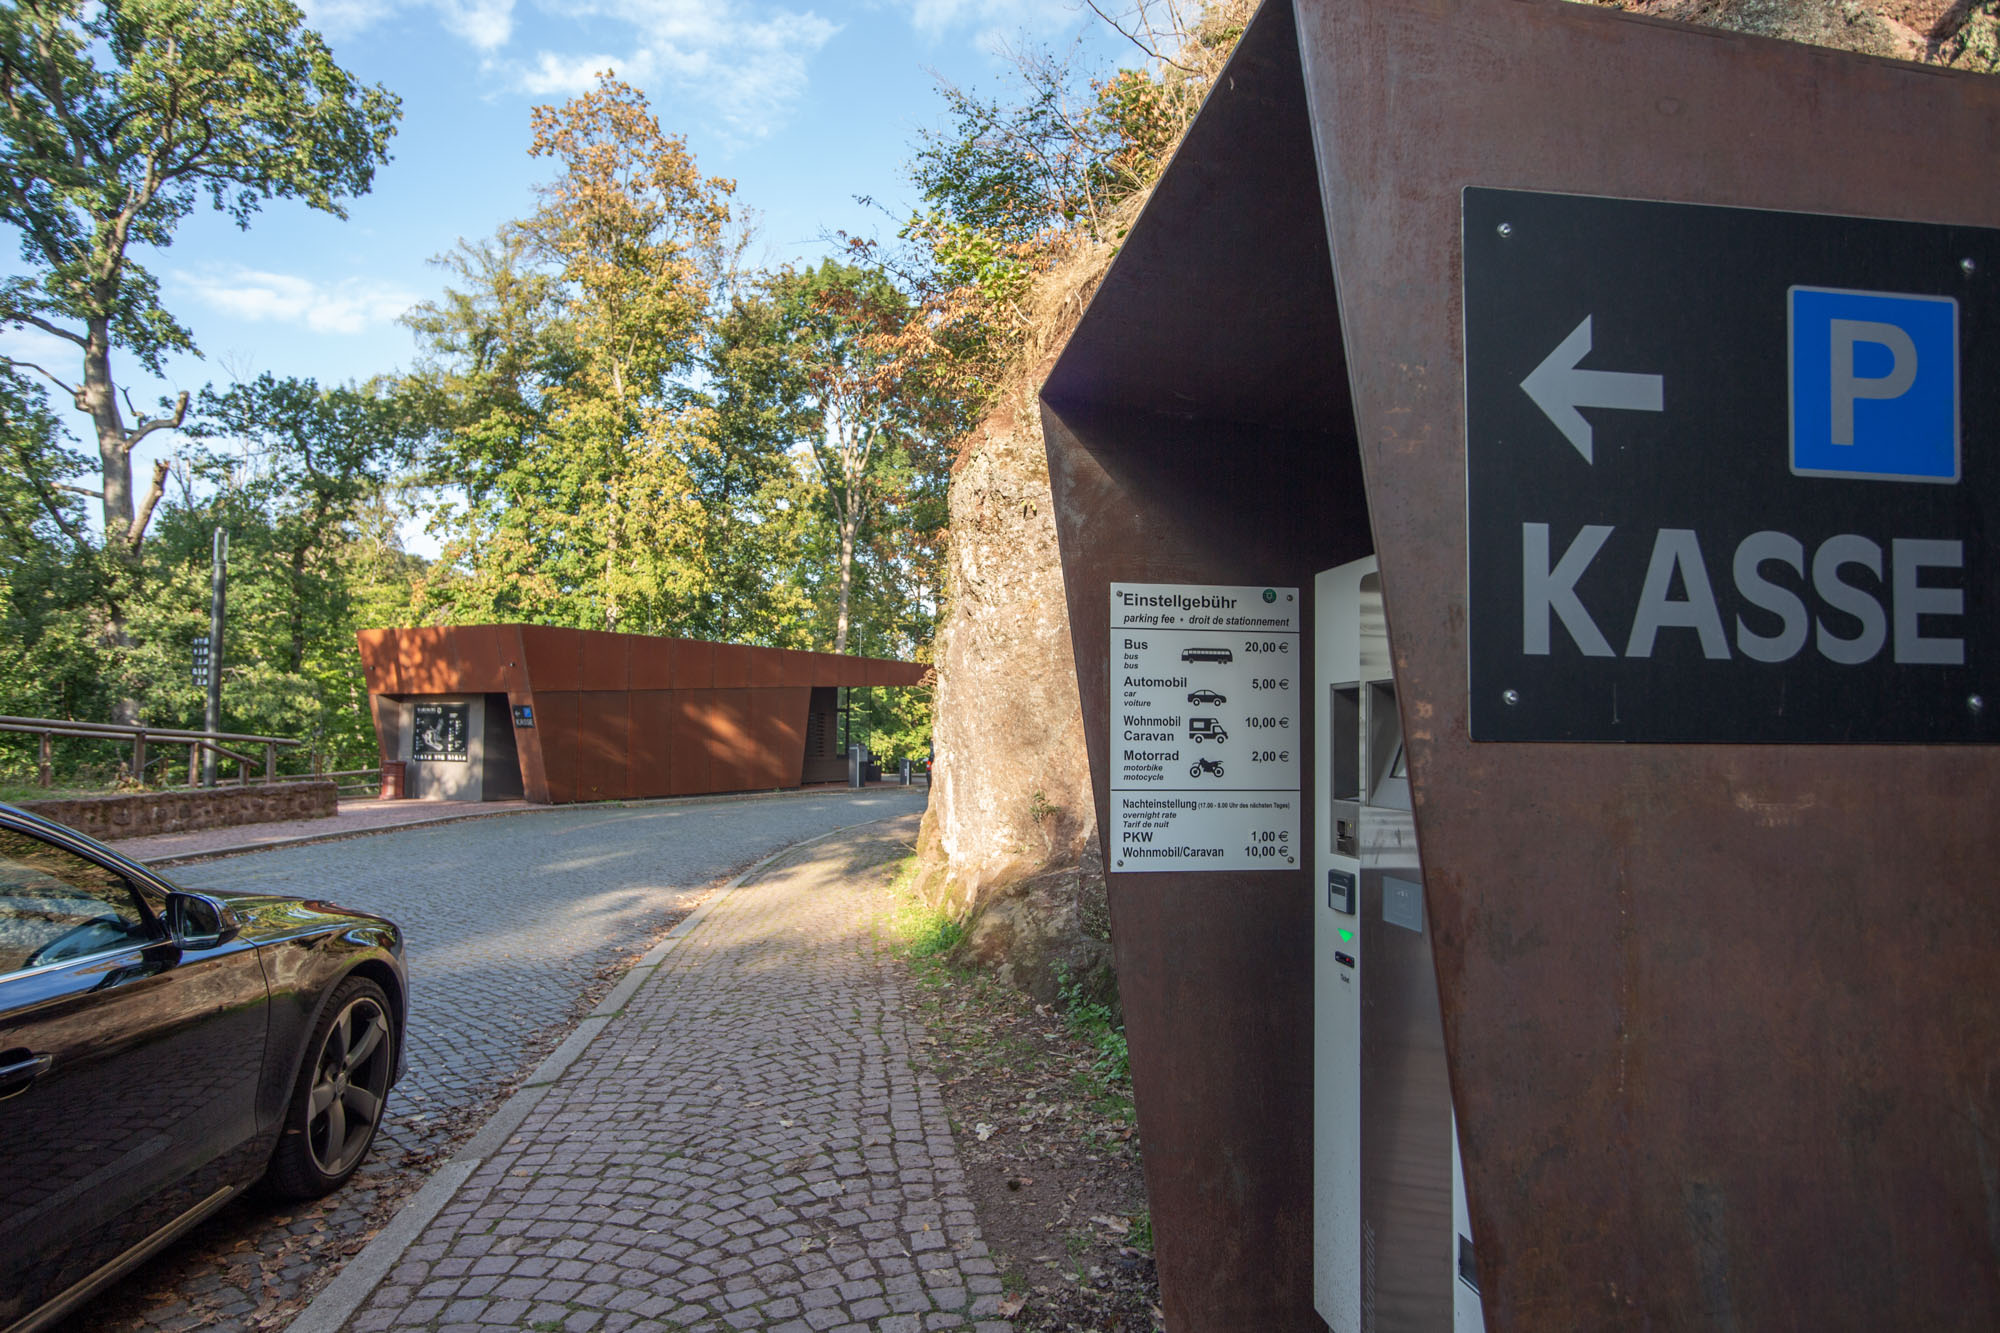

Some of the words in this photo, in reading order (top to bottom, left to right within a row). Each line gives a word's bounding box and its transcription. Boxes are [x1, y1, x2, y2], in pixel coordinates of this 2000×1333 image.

[1830, 318, 1918, 446] P
[1523, 522, 1965, 665] KASSE
[1124, 593, 1237, 610] Einstellgebühr
[1124, 613, 1159, 624] parking
[1161, 614, 1175, 623] fee
[1189, 615, 1210, 624] droit
[1213, 615, 1223, 624] de
[1226, 616, 1289, 626] stationnement
[1124, 639, 1148, 650] Bus
[1245, 642, 1276, 653] 20,00
[1279, 642, 1288, 653] €
[1124, 677, 1187, 687] Automobil
[1253, 679, 1276, 691] 5,00
[1279, 679, 1289, 689] €
[1124, 716, 1180, 726] Wohnmobil
[1246, 717, 1276, 729] 10,00
[1279, 717, 1289, 728] €
[1124, 731, 1174, 741] Caravan
[1124, 750, 1179, 761] Motorrad
[1252, 751, 1276, 763] 2,00
[1279, 751, 1289, 762] €
[1124, 774, 1163, 782] motocycle
[1123, 799, 1196, 810] Nachteinstellung
[1123, 812, 1159, 820] overnight
[1123, 832, 1153, 842] PKW
[1252, 831, 1275, 843] 1,00
[1279, 831, 1288, 842] €
[1123, 847, 1223, 857] Wohnmobil/Caravan
[1245, 846, 1275, 857] 10,00
[1279, 846, 1288, 857] €
